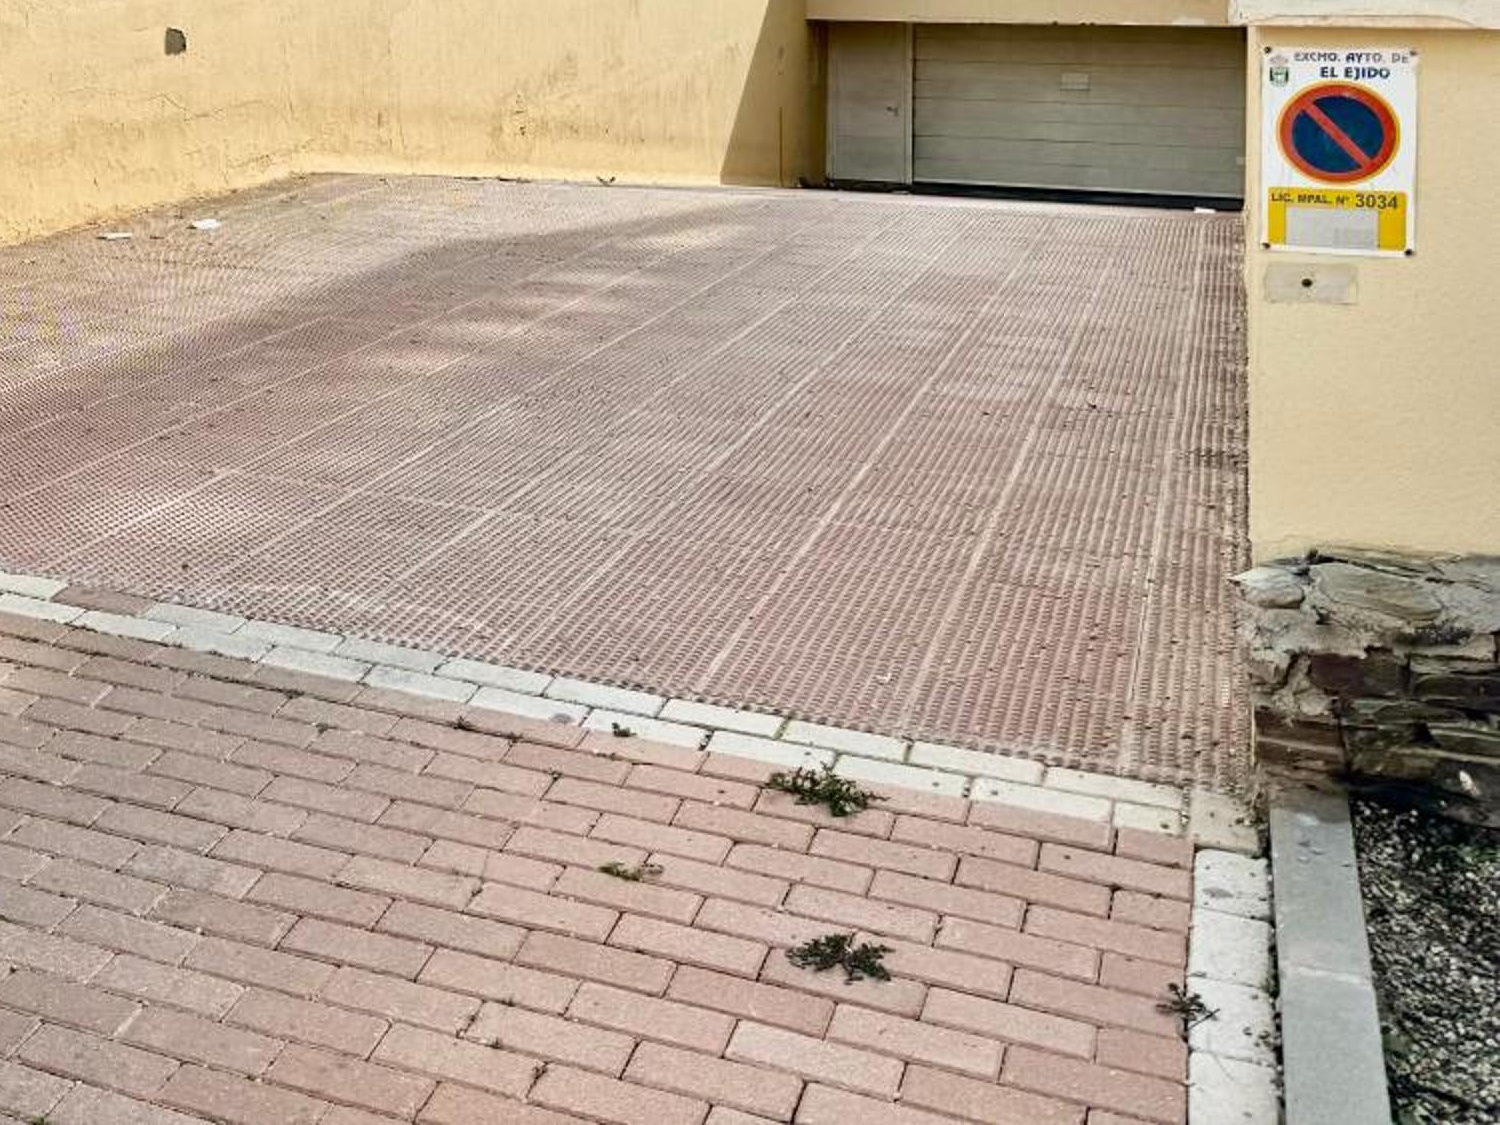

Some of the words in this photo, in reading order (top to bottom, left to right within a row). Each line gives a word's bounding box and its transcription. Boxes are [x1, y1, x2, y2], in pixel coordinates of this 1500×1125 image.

[1294, 52, 1340, 63] EXCMO.
[1391, 53, 1409, 64] DE
[1320, 66, 1339, 78] EL
[1344, 66, 1391, 80] EJIDO
[1271, 192, 1294, 203] LIC.
[1355, 193, 1398, 210] 3034
